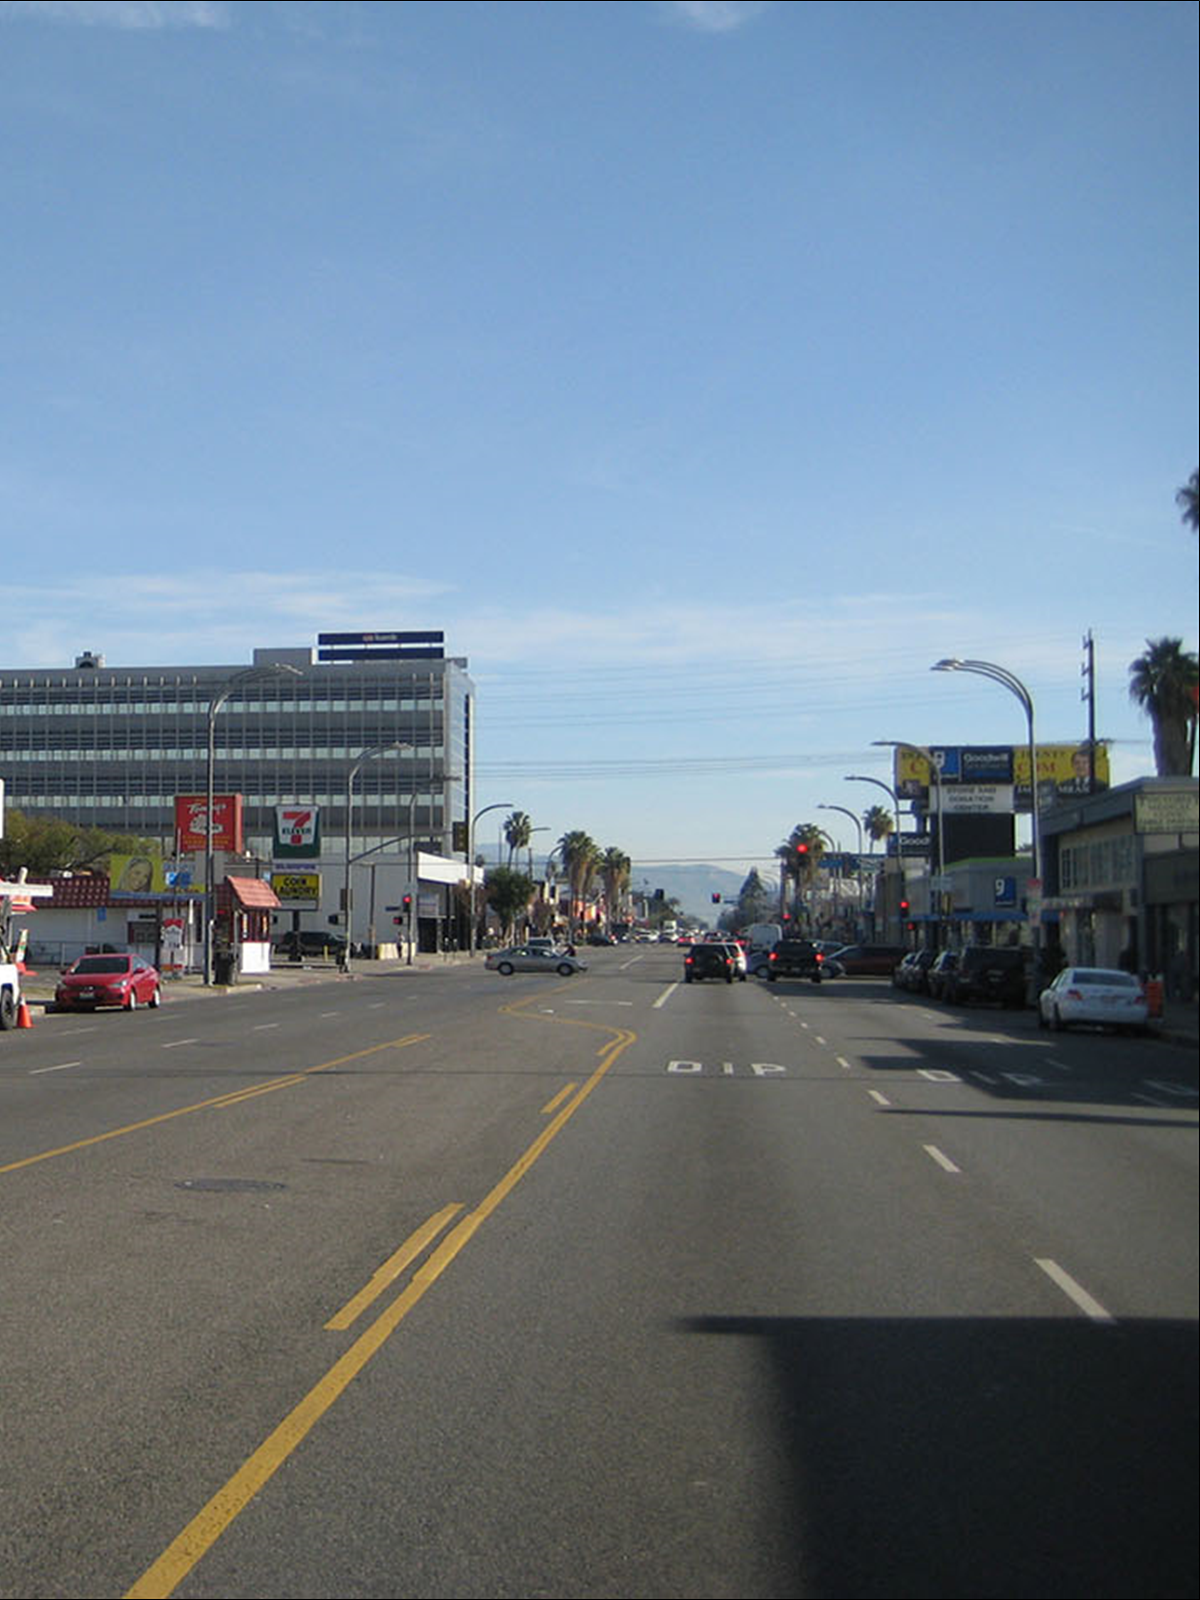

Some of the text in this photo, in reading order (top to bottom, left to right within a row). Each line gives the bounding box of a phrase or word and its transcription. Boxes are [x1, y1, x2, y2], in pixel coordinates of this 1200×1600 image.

[963, 753, 1009, 762] Goodwill
[282, 811, 311, 845] 7
[667, 1060, 787, 1076] DIP
